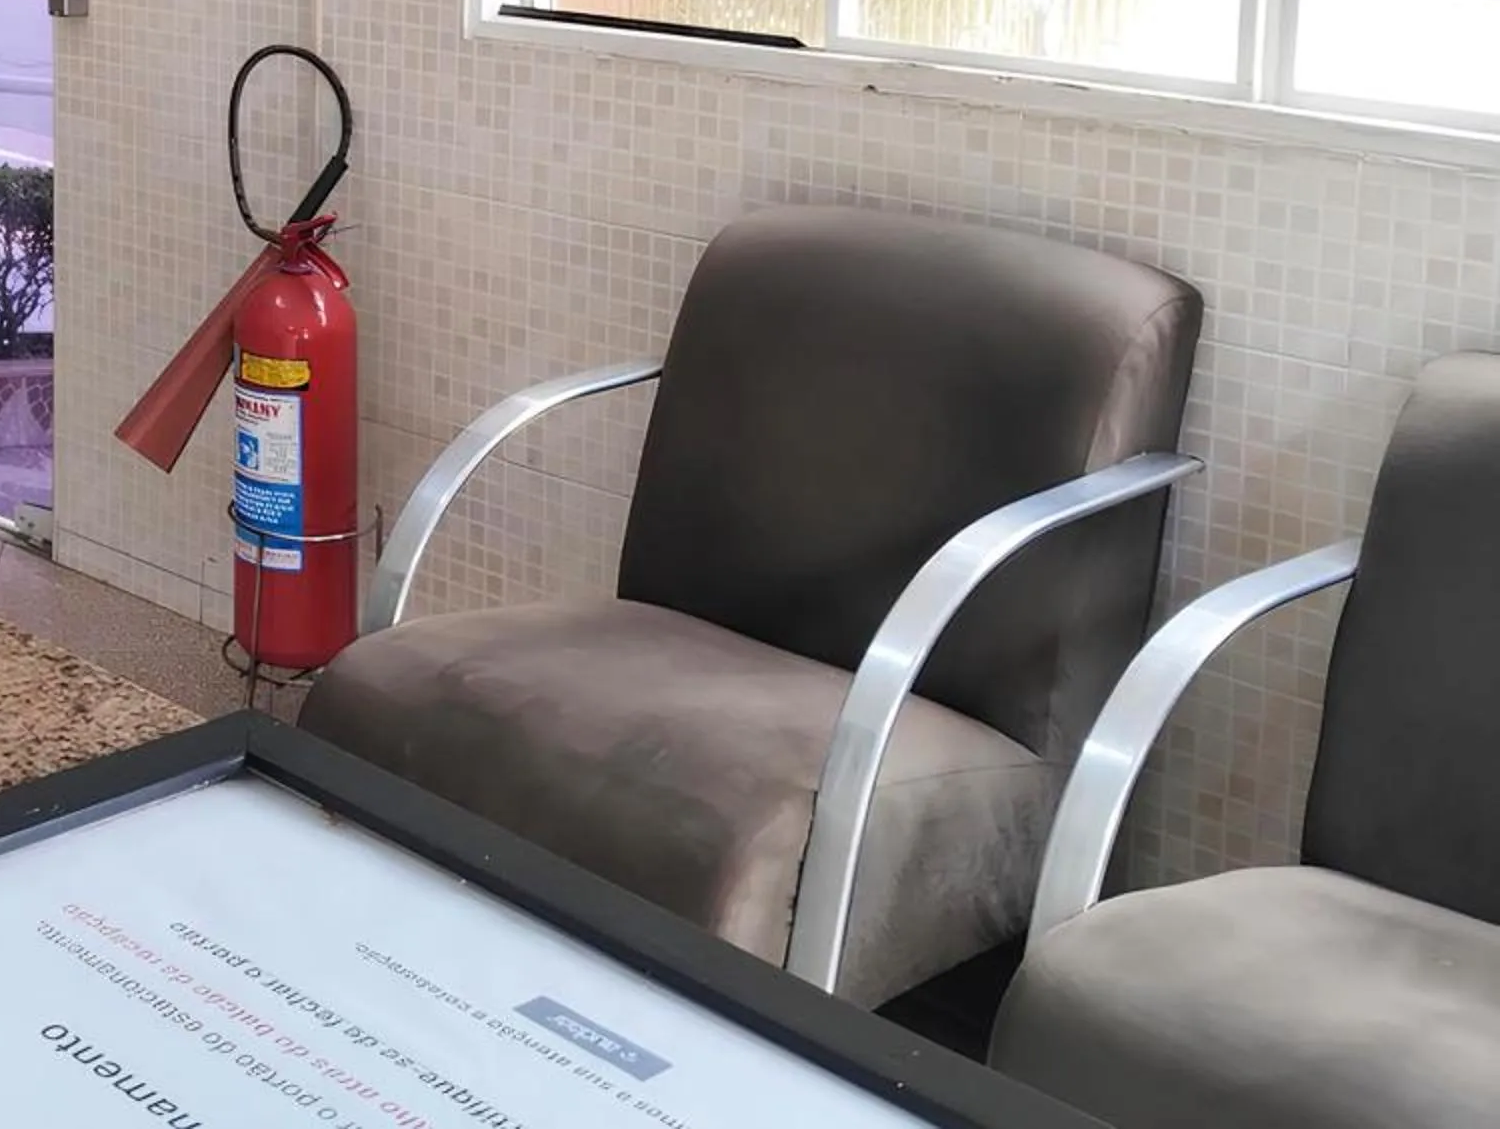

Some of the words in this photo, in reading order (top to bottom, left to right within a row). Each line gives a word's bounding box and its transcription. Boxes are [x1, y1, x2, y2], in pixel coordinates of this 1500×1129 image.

[202, 1031, 237, 1055] do
[275, 1035, 310, 1058] do
[41, 1023, 203, 1129] namento
[235, 1053, 323, 1107] portão
